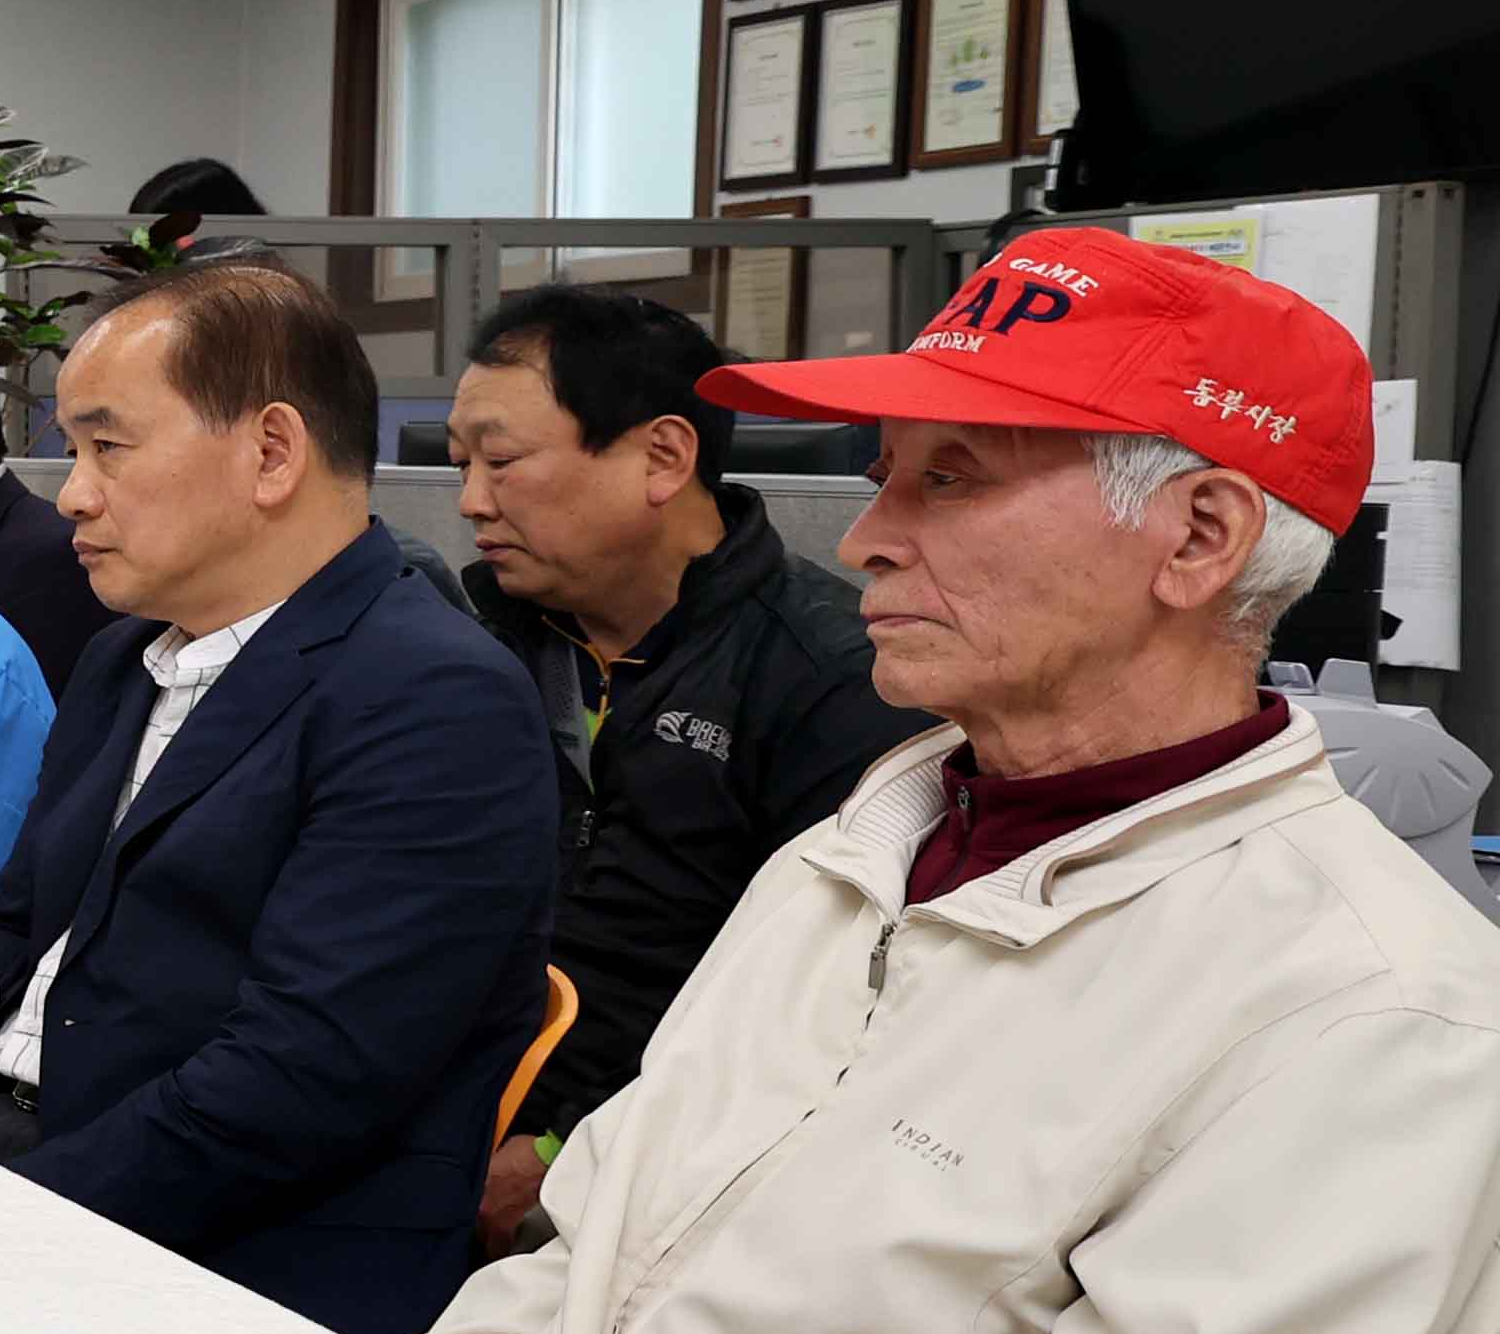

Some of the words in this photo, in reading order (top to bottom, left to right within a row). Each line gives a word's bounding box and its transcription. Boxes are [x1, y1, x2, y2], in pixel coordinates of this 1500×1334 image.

[1008, 257, 1100, 298] GAME
[943, 277, 1073, 336] AP
[891, 1118, 965, 1167] INDIAN
